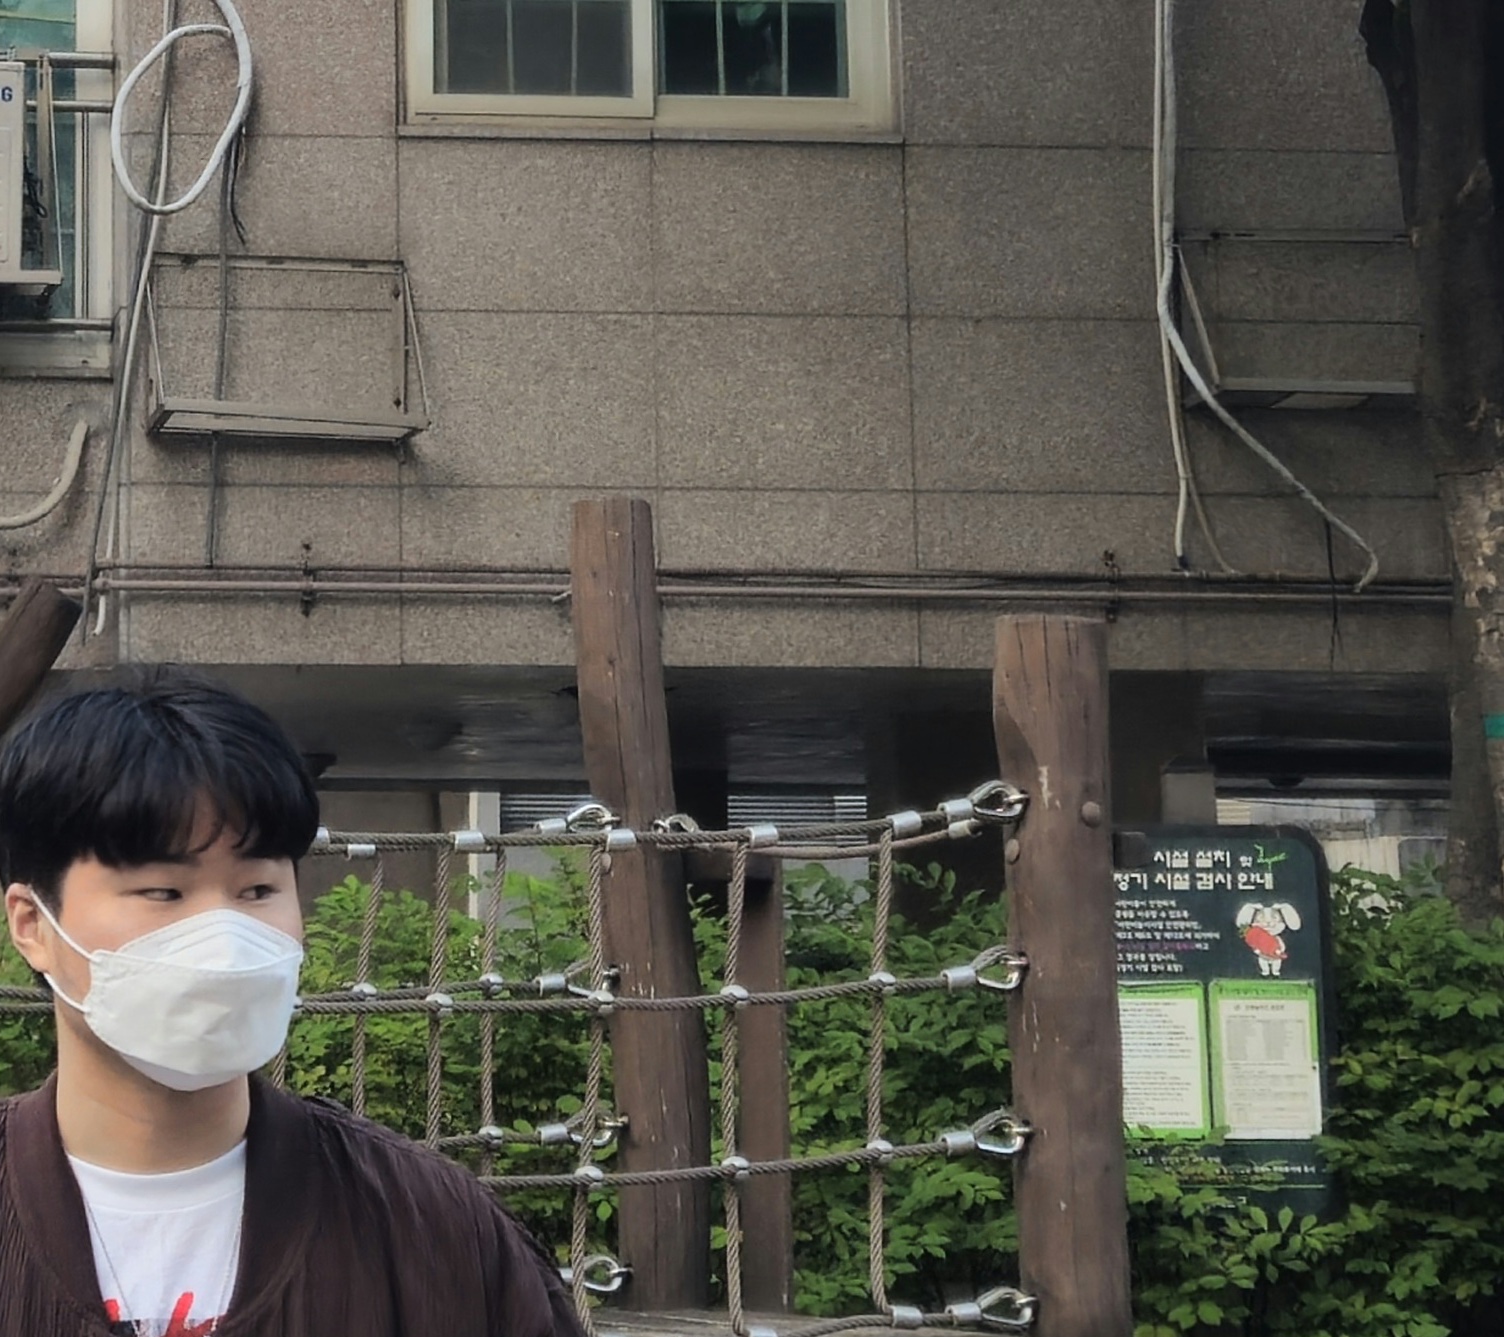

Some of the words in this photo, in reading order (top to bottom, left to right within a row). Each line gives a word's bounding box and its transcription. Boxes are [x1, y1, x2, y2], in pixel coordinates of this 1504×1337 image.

[1153, 850, 1189, 869] 시설
[1195, 850, 1231, 869] 설치
[1113, 872, 1148, 891] 정기
[1155, 872, 1191, 891] 시설
[1197, 872, 1232, 891] 검사
[1237, 871, 1275, 891] 안내
